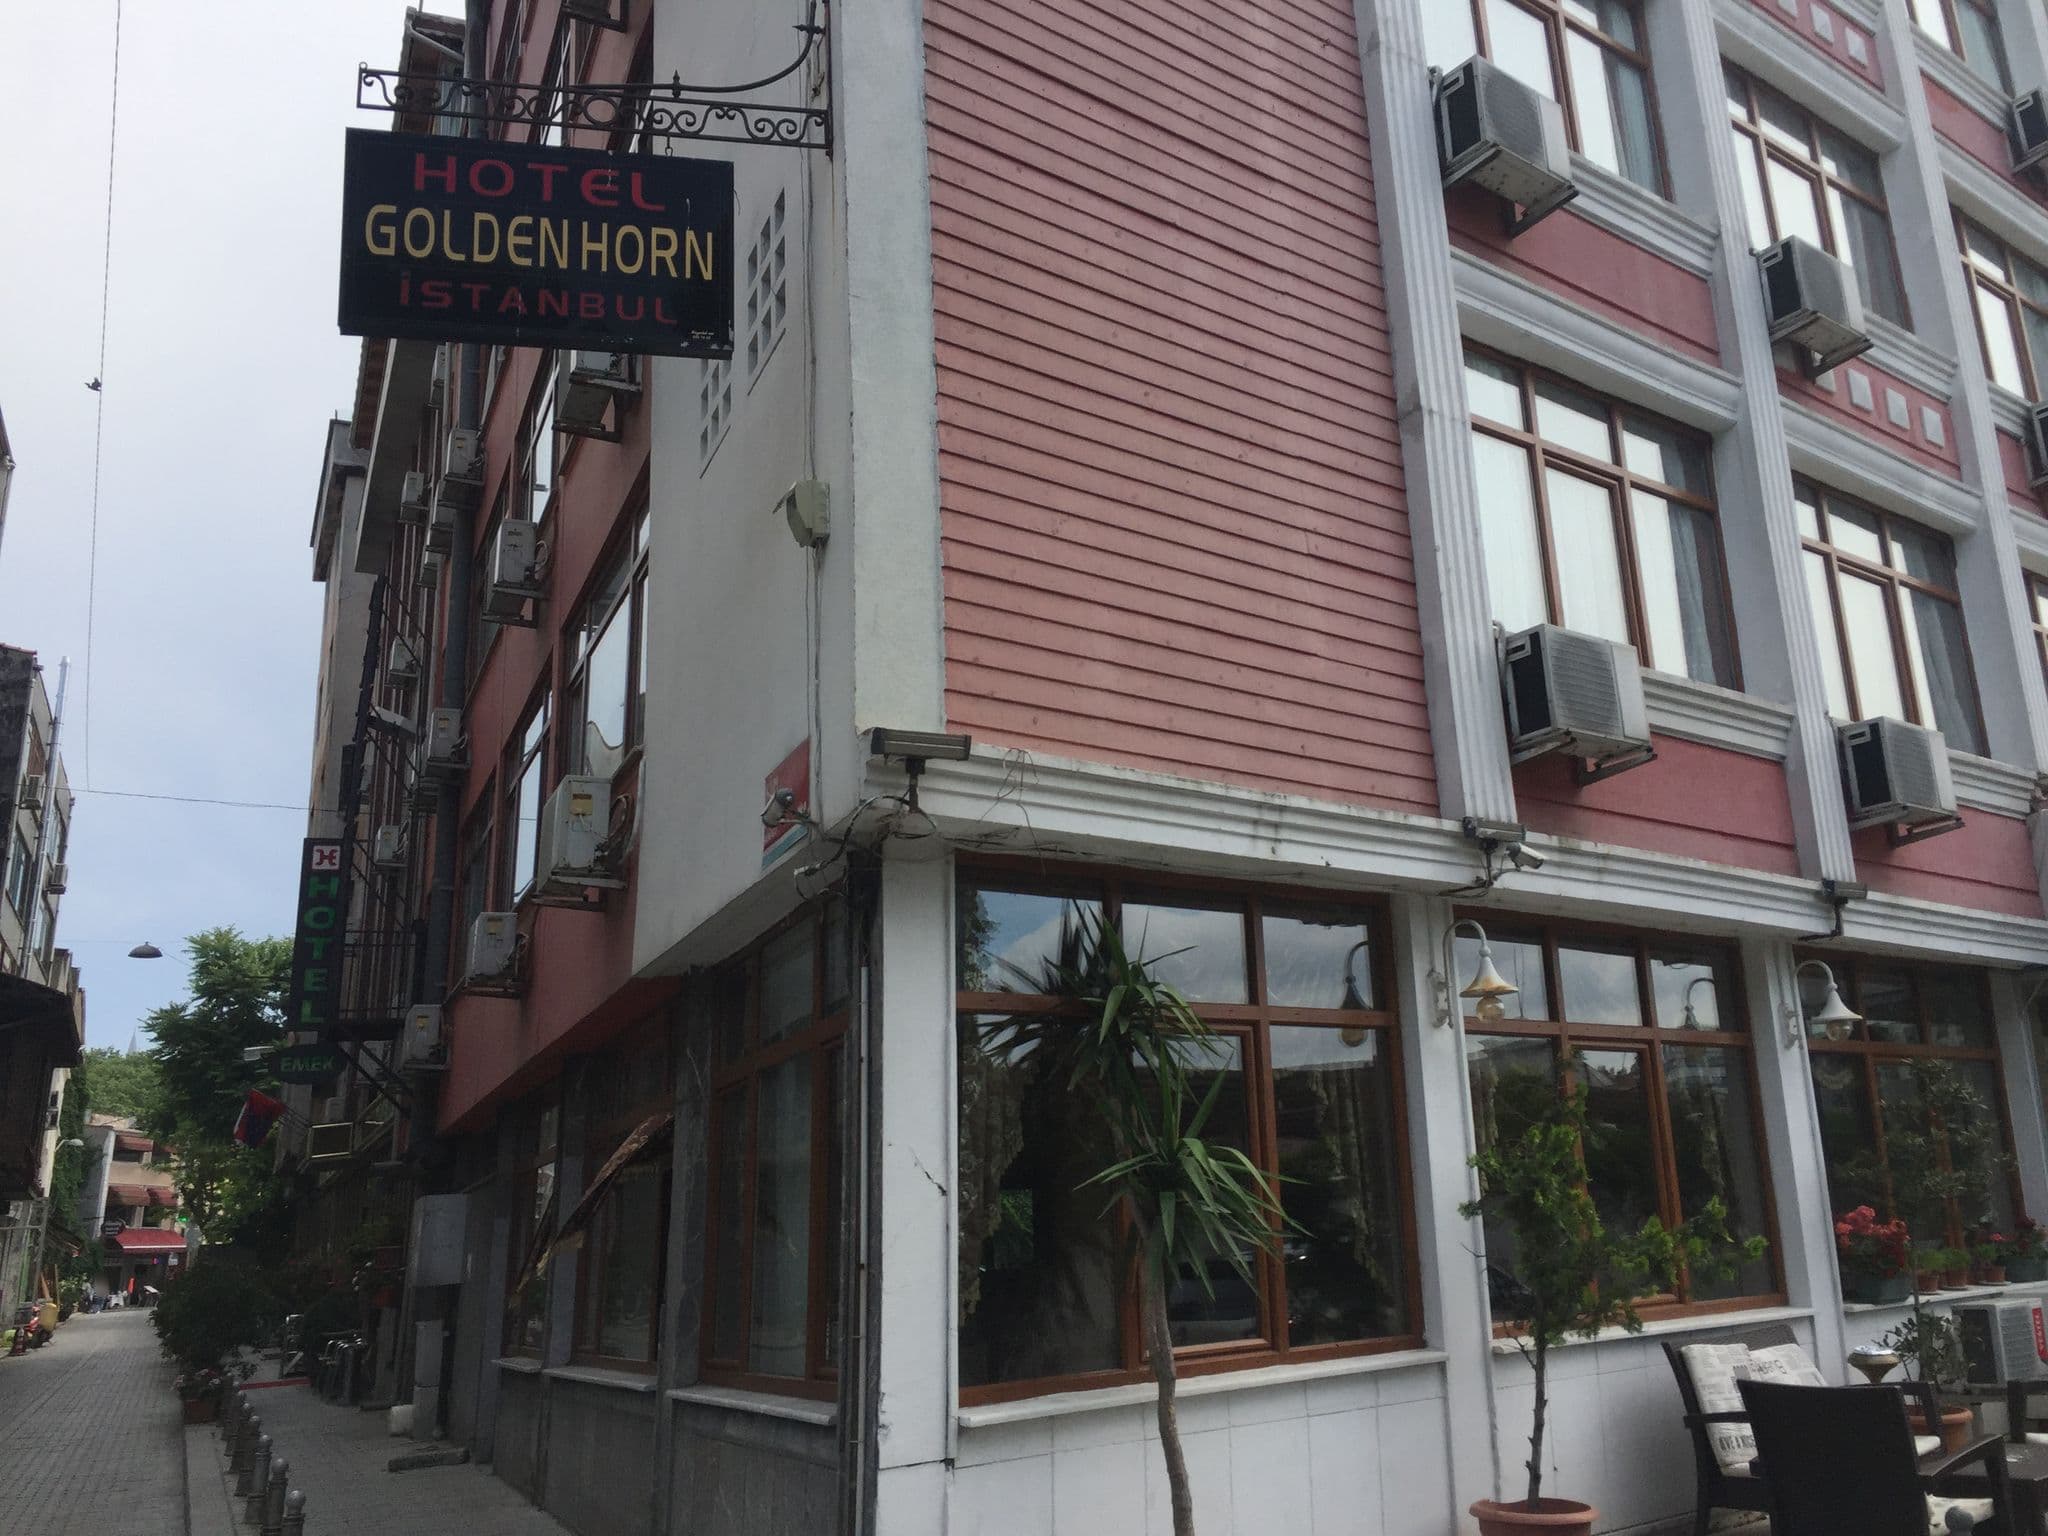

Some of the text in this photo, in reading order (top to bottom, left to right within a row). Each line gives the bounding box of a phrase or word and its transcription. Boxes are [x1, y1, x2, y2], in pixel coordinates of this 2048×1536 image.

[412, 152, 666, 212] HOTEL
[398, 271, 679, 326] İSTANBUL
[300, 875, 341, 1024] HOTEL
